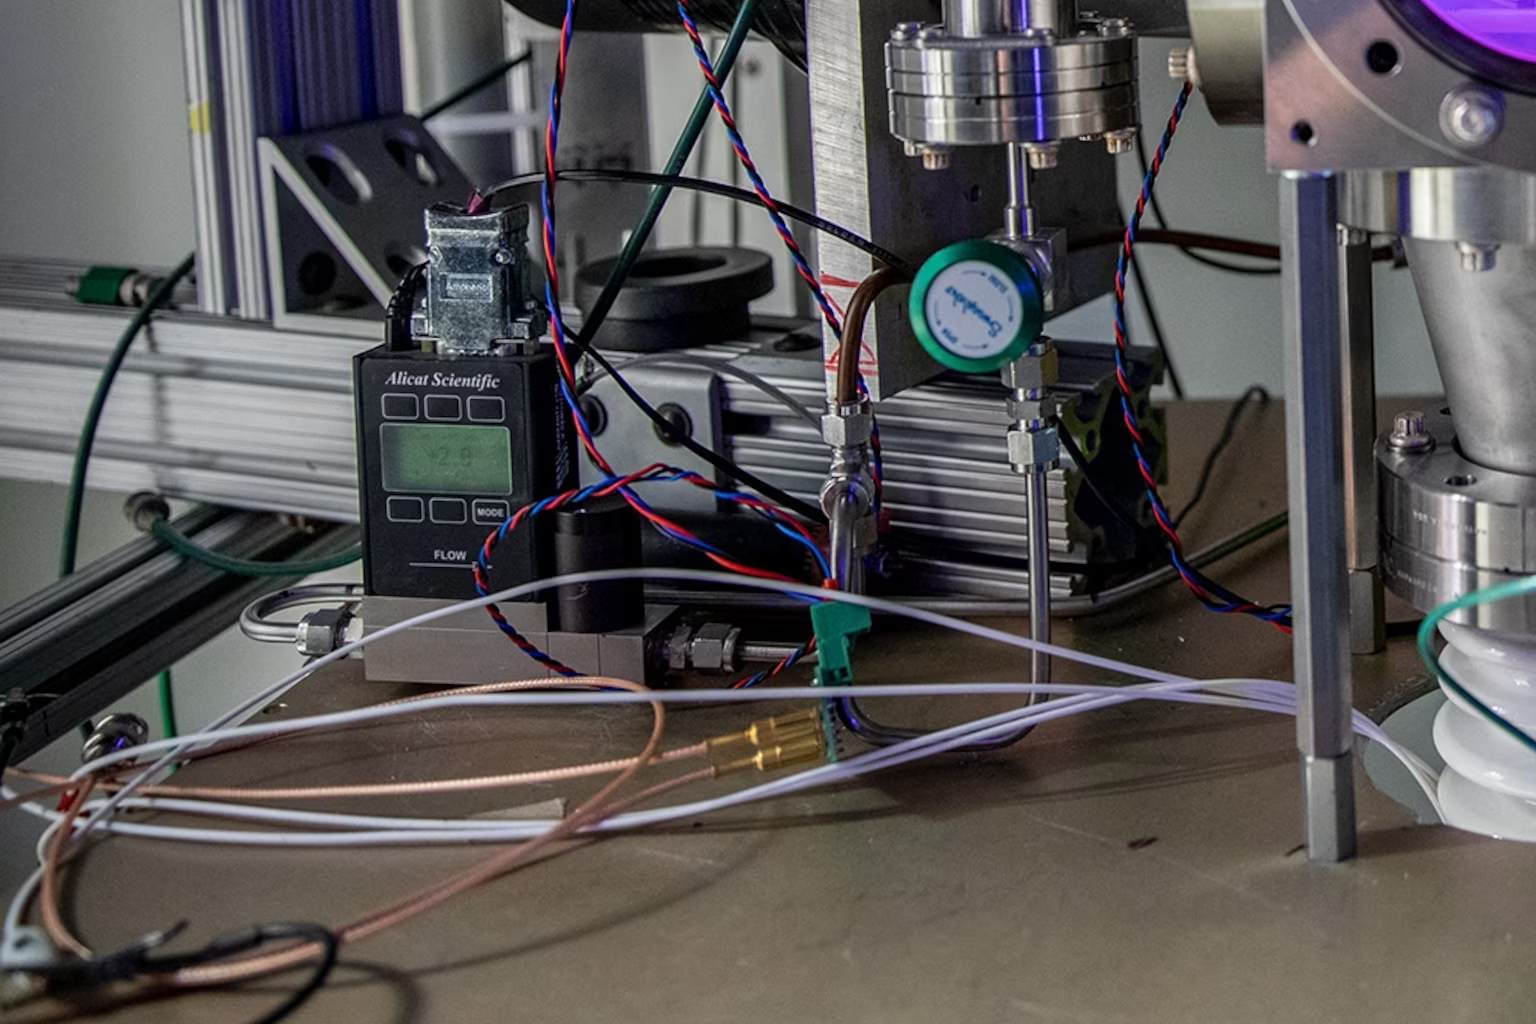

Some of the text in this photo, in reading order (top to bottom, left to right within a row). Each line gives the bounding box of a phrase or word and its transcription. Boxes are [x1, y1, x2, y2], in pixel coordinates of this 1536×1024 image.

[385, 371, 500, 392] Alicat Scientific
[476, 507, 504, 518] MODE
[433, 549, 468, 561] FLOW
